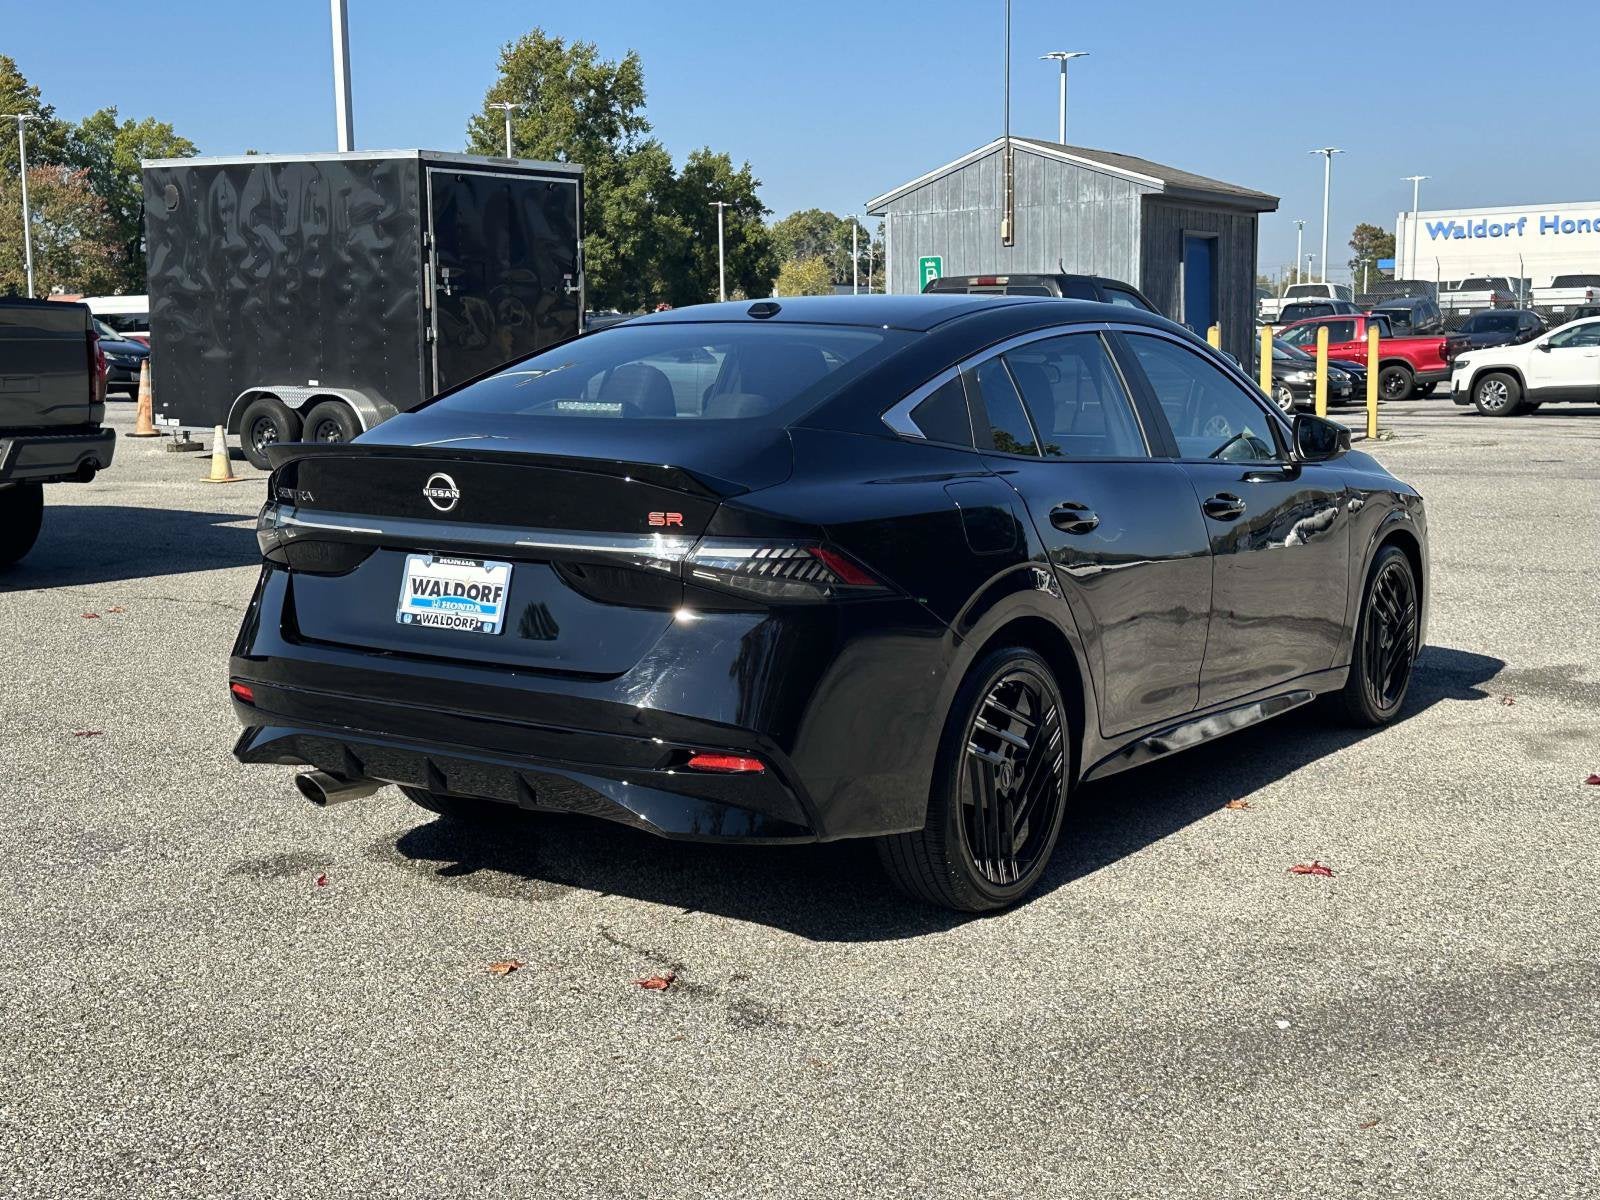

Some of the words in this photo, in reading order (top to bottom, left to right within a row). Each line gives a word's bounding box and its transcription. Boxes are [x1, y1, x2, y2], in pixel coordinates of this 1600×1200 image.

[1425, 217, 1527, 240] Waldorf
[423, 488, 460, 499] NISSAN
[648, 512, 684, 527] SR
[411, 578, 503, 604] WALDORF
[441, 600, 481, 612] HONDA
[422, 613, 477, 629] WALDORF
